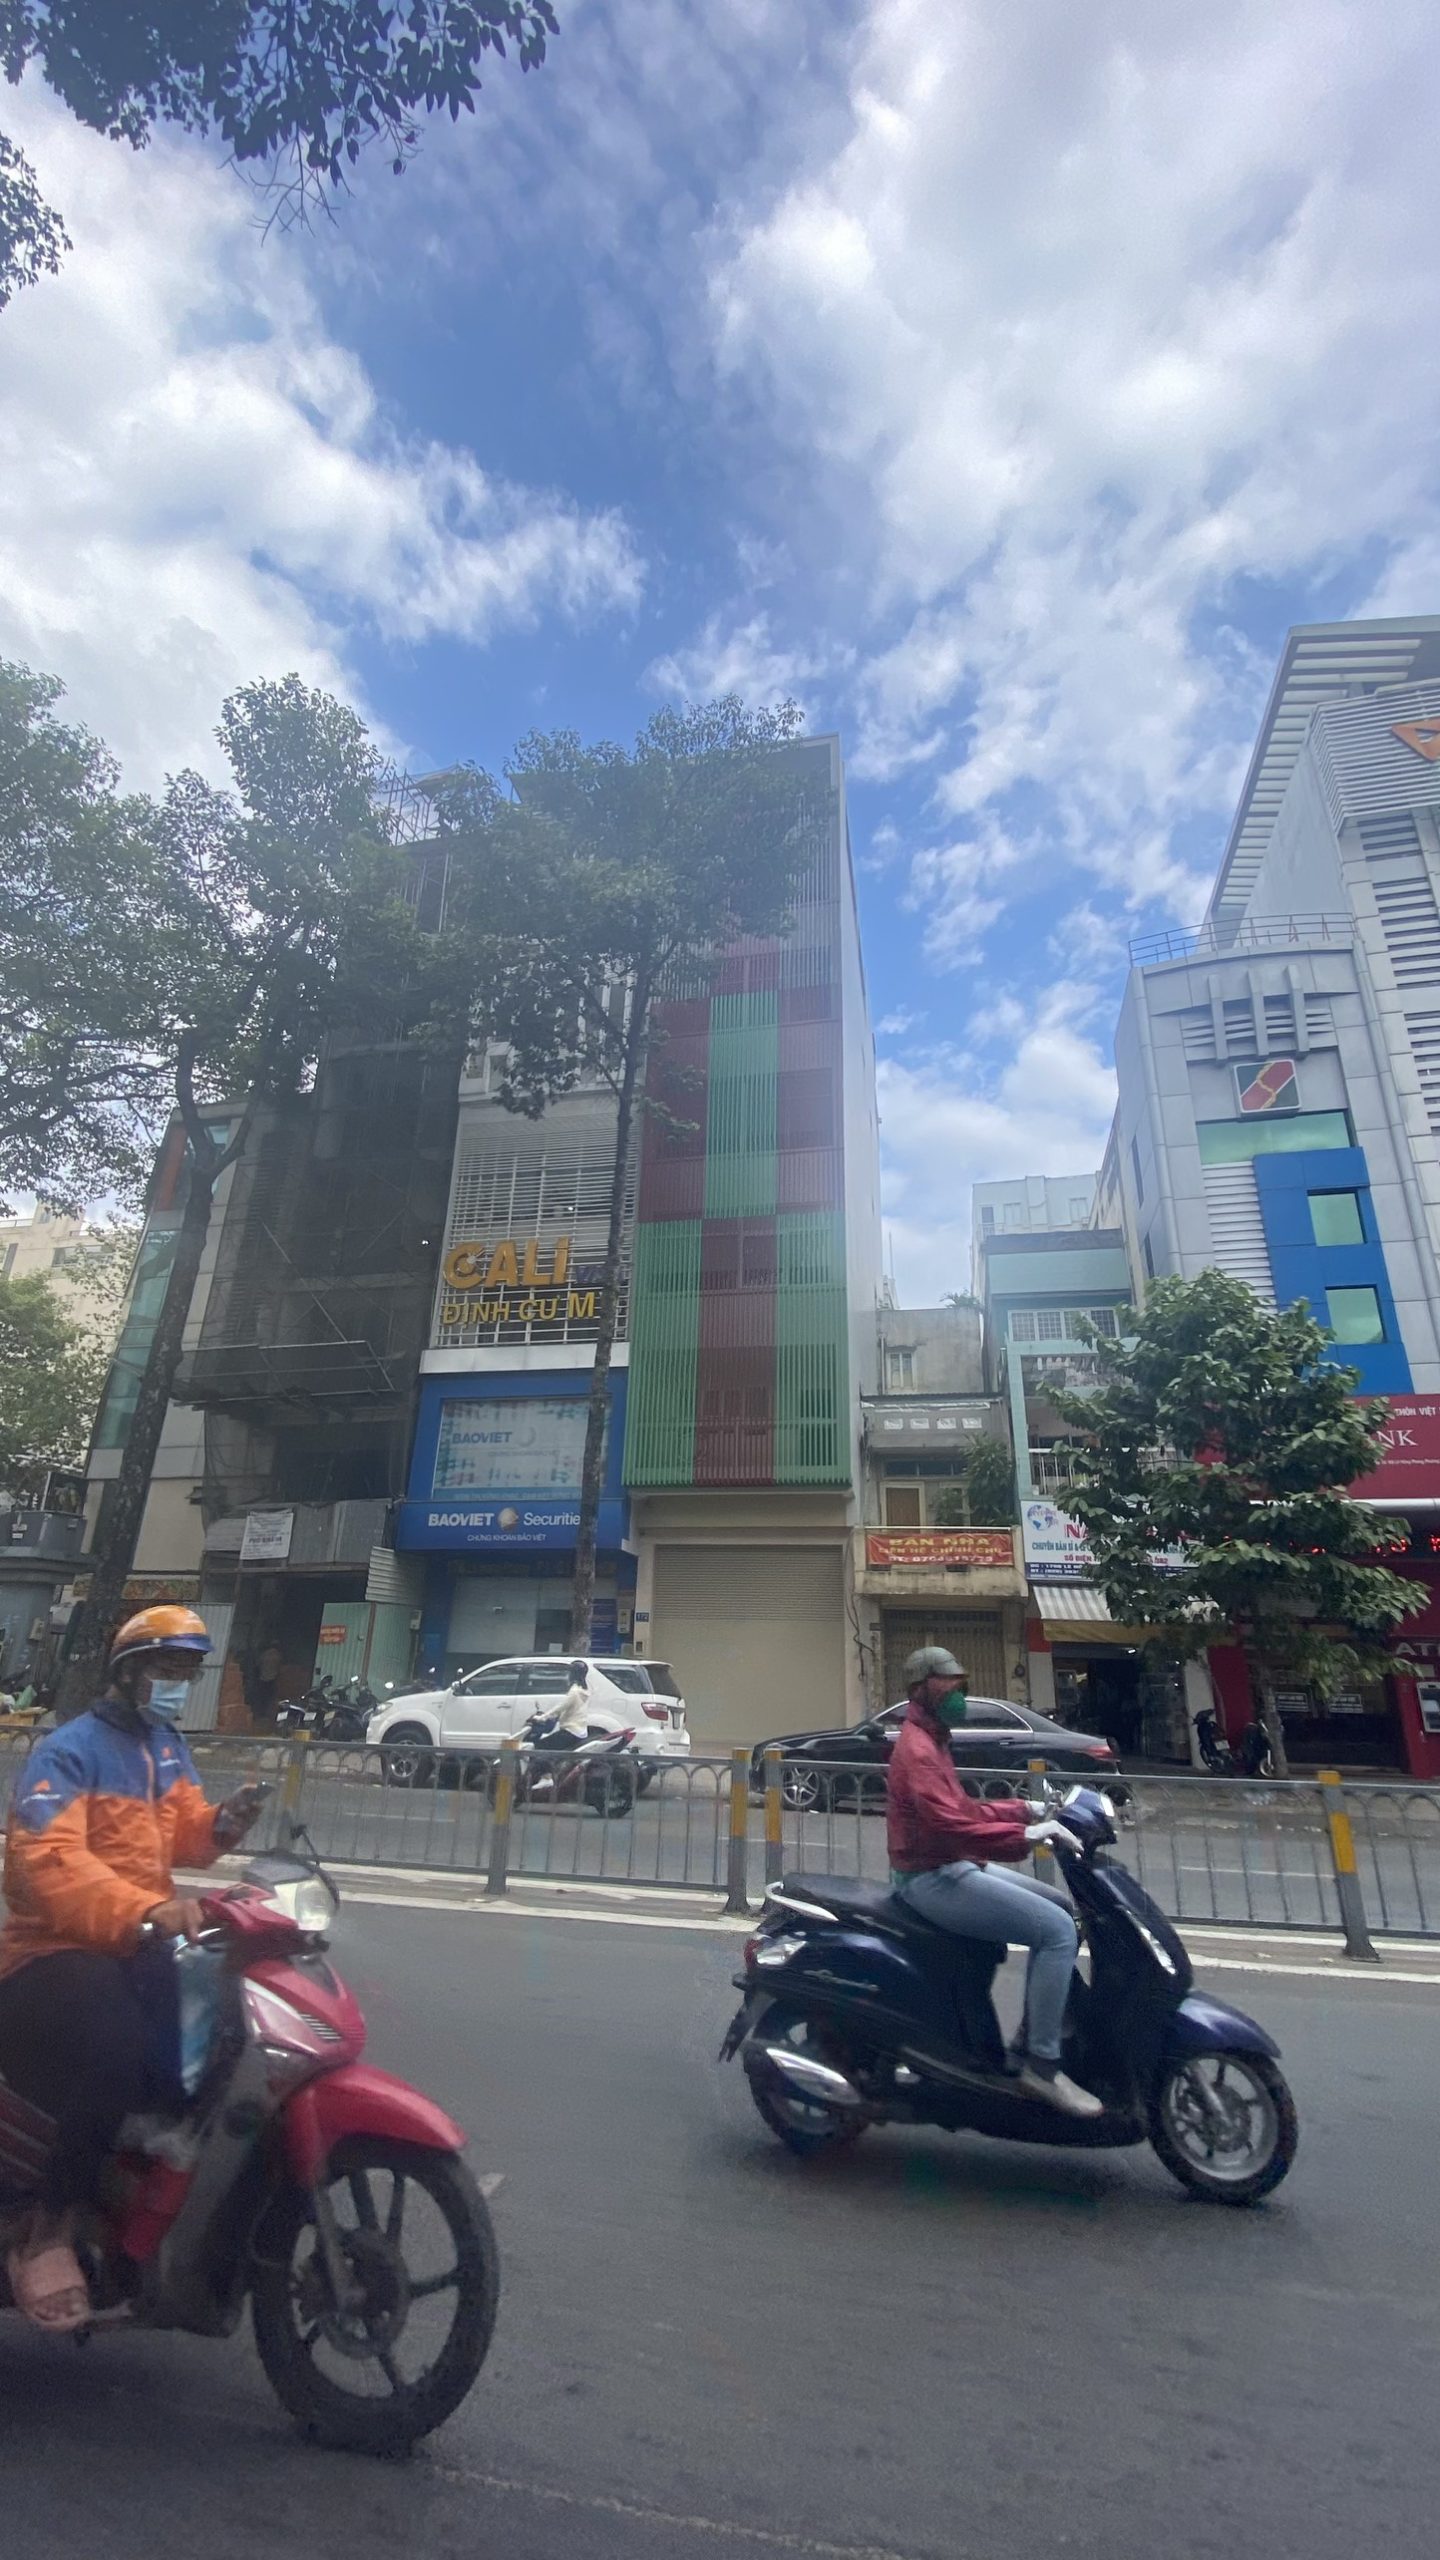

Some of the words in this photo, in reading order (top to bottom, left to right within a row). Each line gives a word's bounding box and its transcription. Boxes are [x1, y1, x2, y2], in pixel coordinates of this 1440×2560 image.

[443, 1236, 571, 1290] CALI
[442, 1301, 511, 1328] ĐỊNH
[519, 1295, 562, 1322] CƯ
[1418, 1405, 1437, 1417] VIỆT
[452, 1431, 513, 1444] BAOVIET
[428, 1513, 495, 1526] BAOVIET
[523, 1511, 581, 1527] Securitie
[1395, 1642, 1440, 1656] AT
